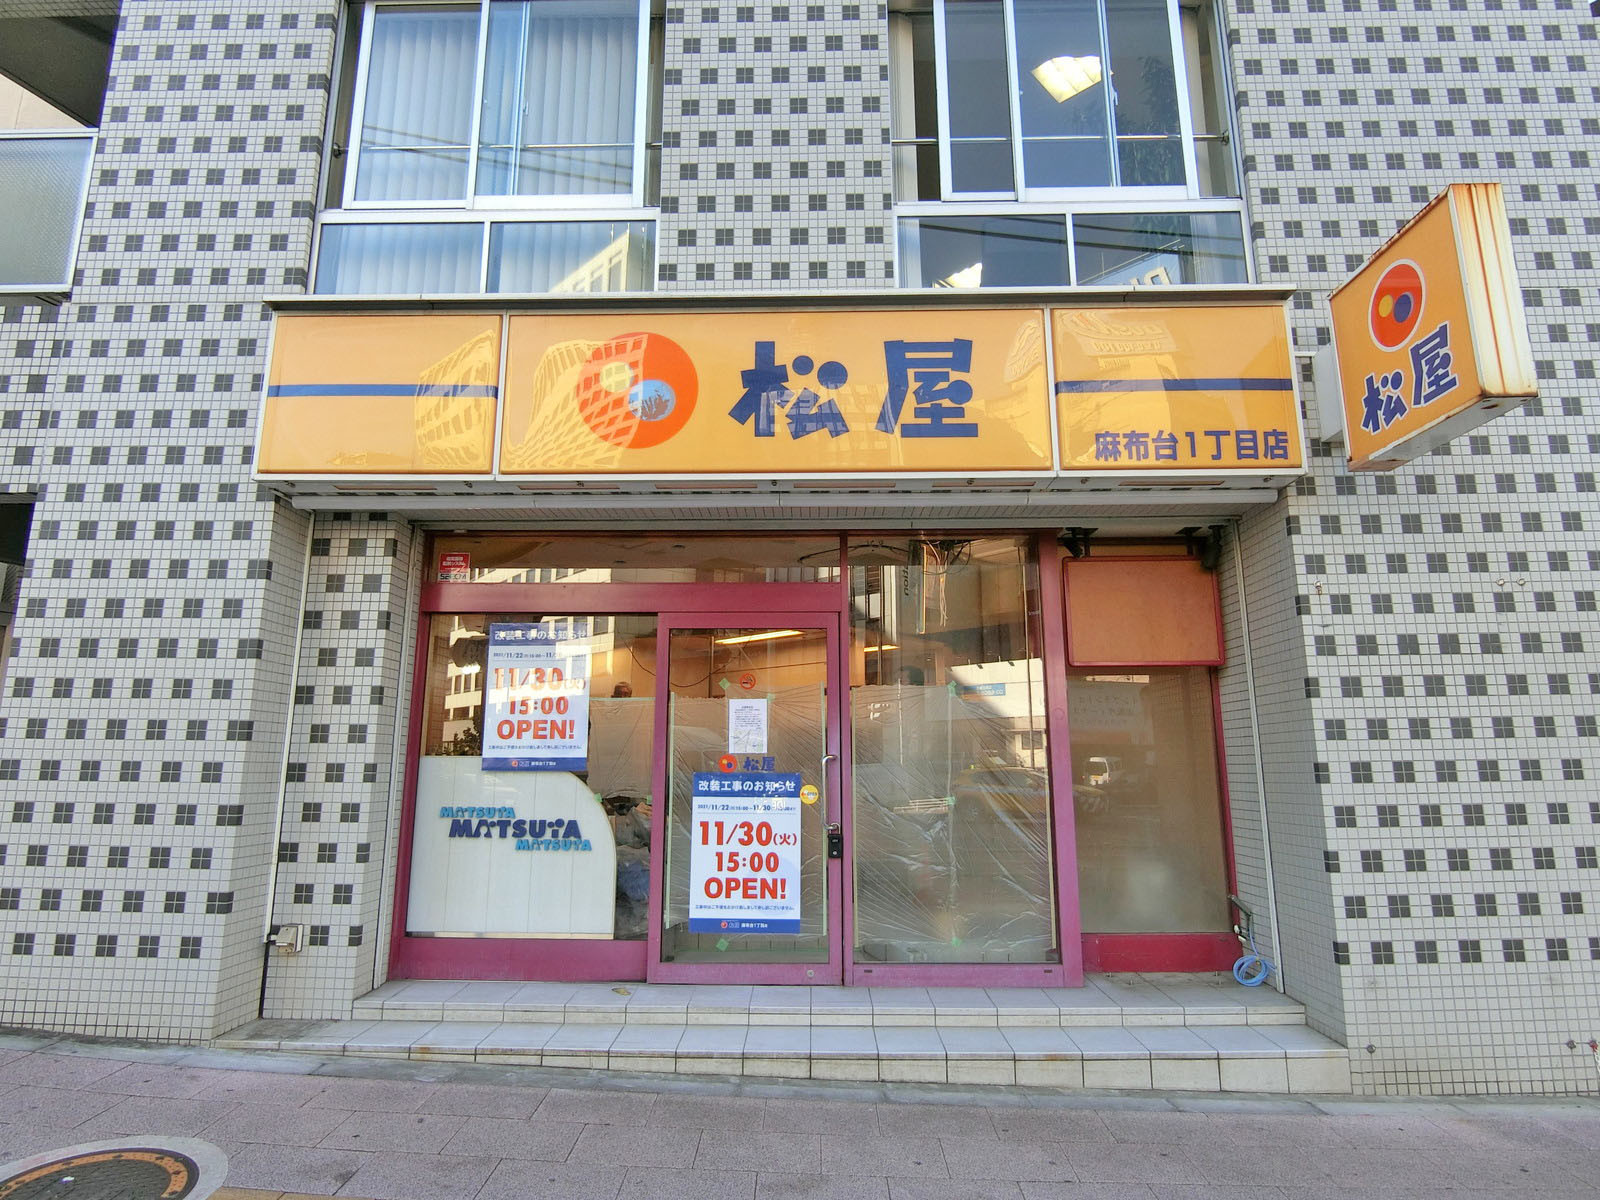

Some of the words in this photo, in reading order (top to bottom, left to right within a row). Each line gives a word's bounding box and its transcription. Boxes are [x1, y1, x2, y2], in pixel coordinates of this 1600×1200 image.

[1361, 322, 1458, 434] 松屋
[728, 338, 979, 440] 松屋
[1094, 429, 1289, 462] 麻布台1丁目店
[509, 695, 569, 716] 15:00
[496, 719, 575, 740] OPEN!
[743, 756, 776, 772] 松屋
[698, 780, 796, 792] 改装工事のお知らせ
[440, 806, 516, 819] MATSUYA
[448, 818, 582, 839] MATSUYA
[699, 820, 798, 847] 11/30(火)
[515, 838, 593, 851] MATSUYA
[715, 851, 780, 873] 15:00
[703, 876, 787, 900] OPEN!
